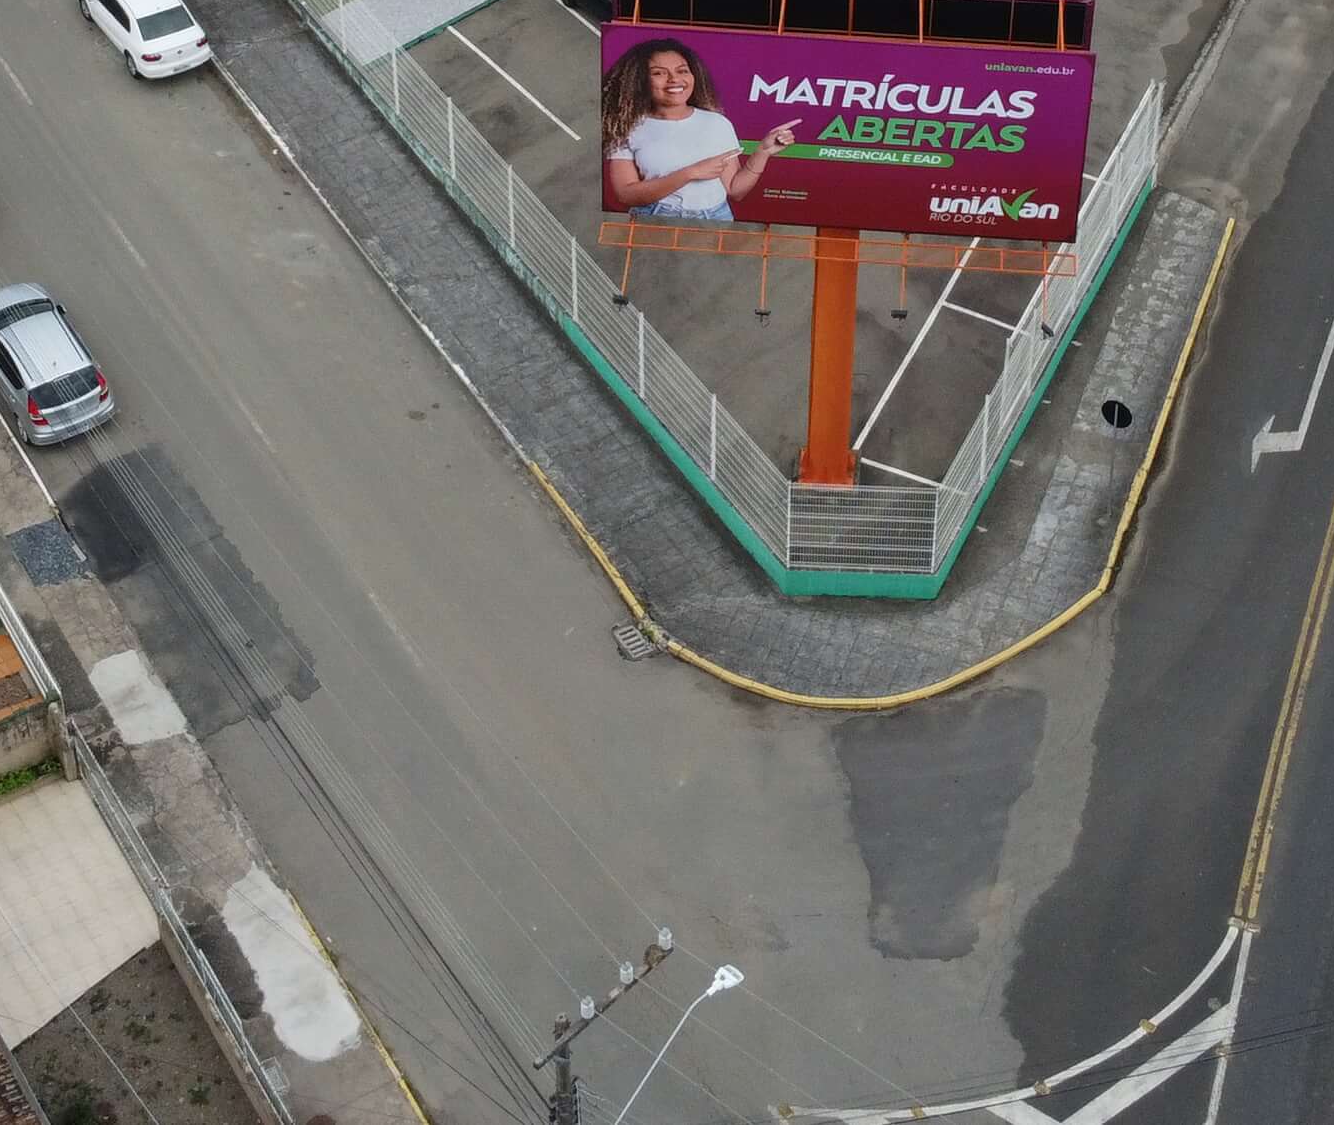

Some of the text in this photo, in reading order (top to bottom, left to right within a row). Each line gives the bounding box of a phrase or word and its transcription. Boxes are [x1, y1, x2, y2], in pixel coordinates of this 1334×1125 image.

[984, 62, 1076, 76] uniavan.edu.br
[748, 73, 1037, 119] MATRÍCULAS
[818, 115, 1027, 153] ABERTAS
[818, 148, 942, 165] PRESENCIAL E EAD
[930, 183, 1017, 195] FACULDADE
[929, 212, 998, 225] RIO DO SUL
